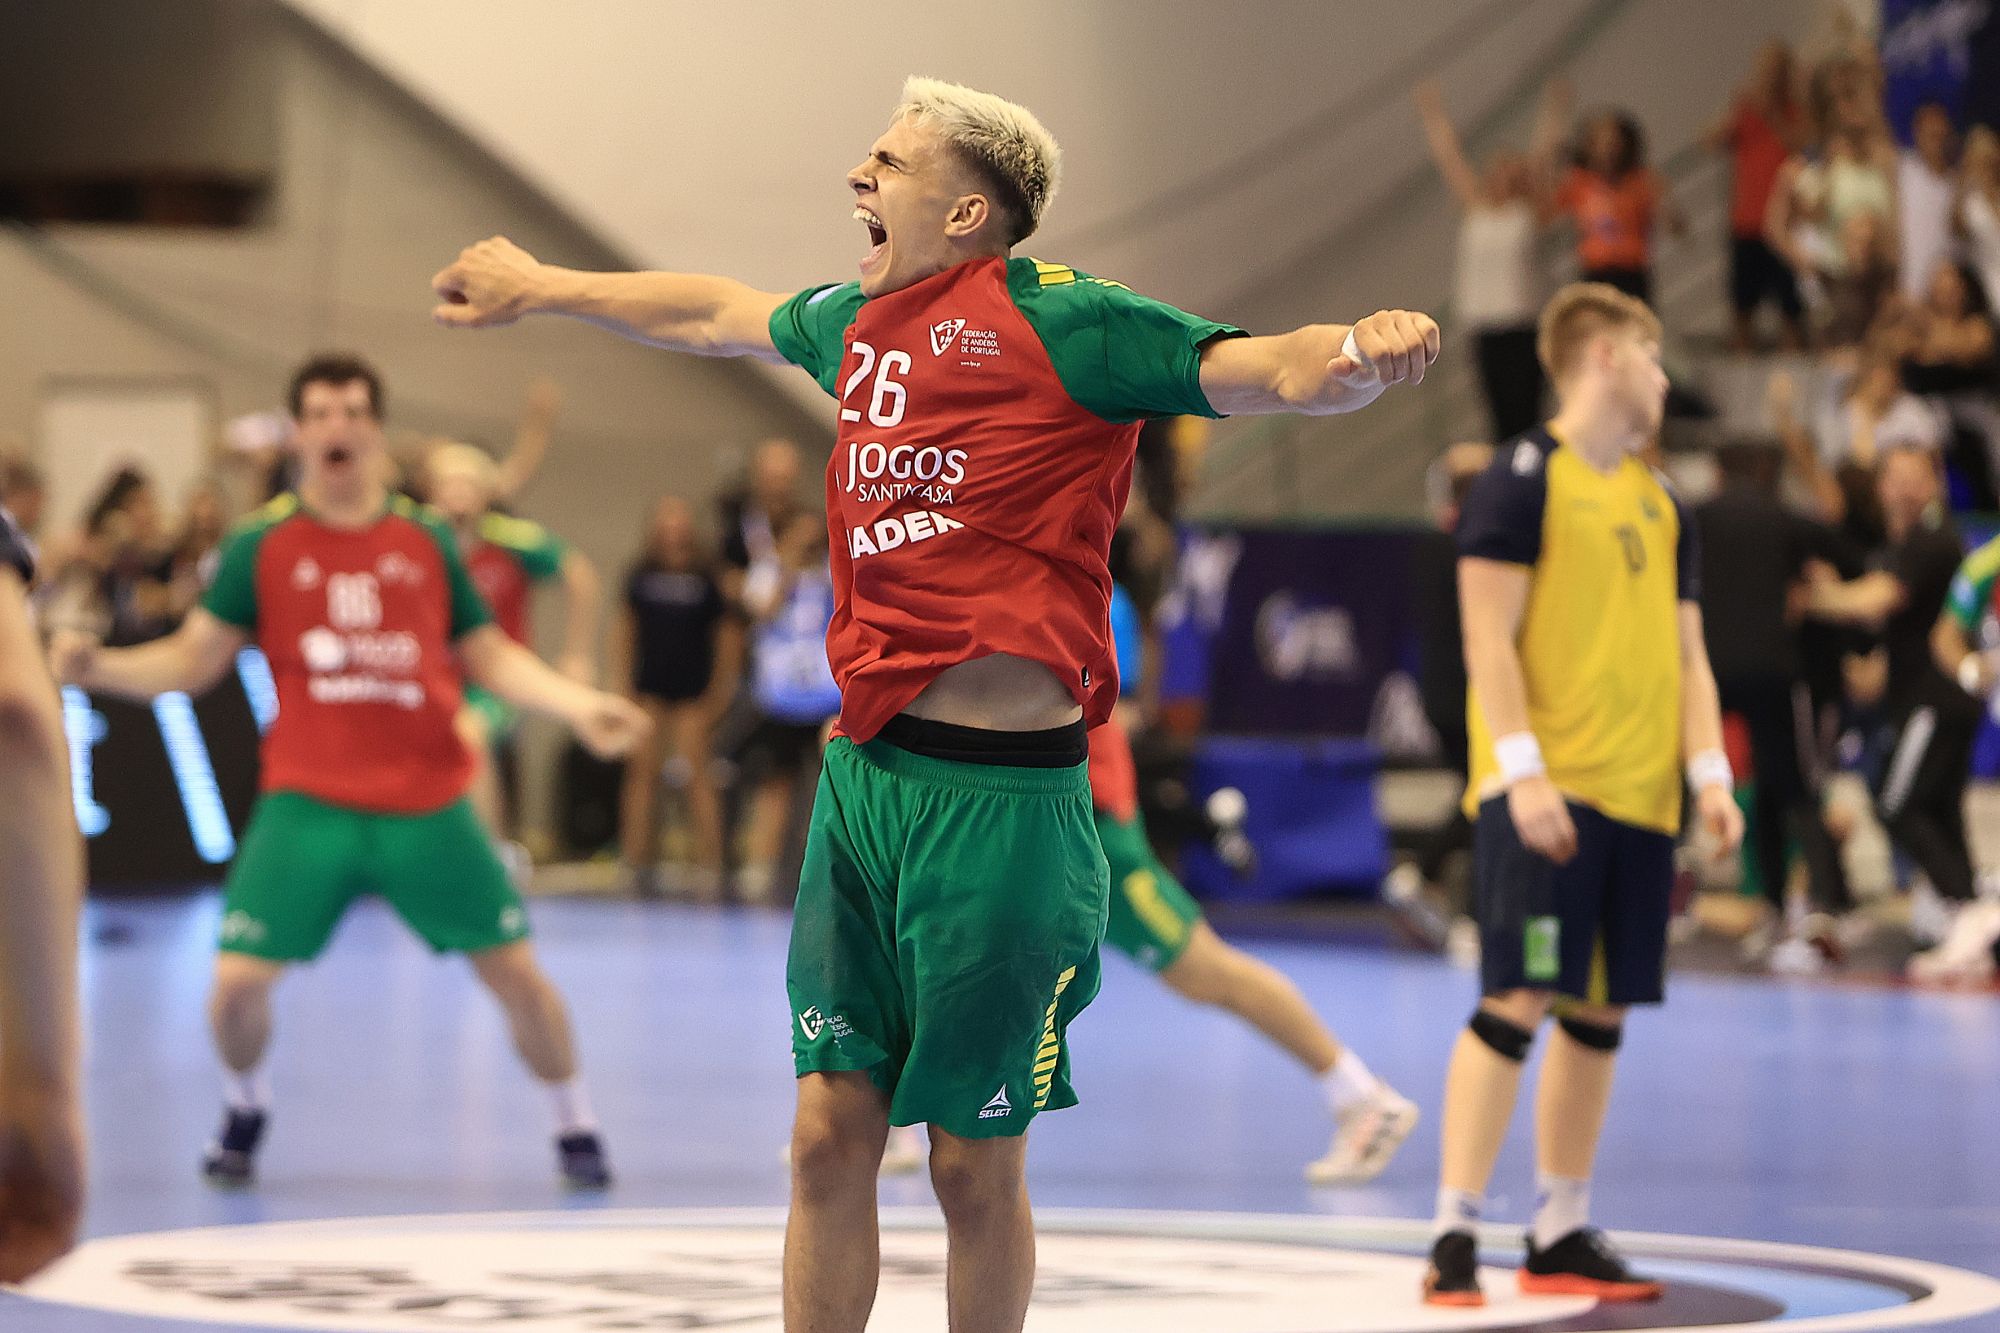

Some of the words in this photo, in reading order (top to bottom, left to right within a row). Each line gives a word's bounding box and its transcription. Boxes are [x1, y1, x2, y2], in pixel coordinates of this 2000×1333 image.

[962, 330, 997, 339] FEDERAÇÃO
[961, 337, 970, 345] DE
[970, 339, 999, 348] ANDEBOL
[970, 347, 1001, 356] PORTUGAL
[841, 341, 912, 428] 26
[845, 442, 969, 493] JOGOS
[978, 1108, 1012, 1119] SELECT
